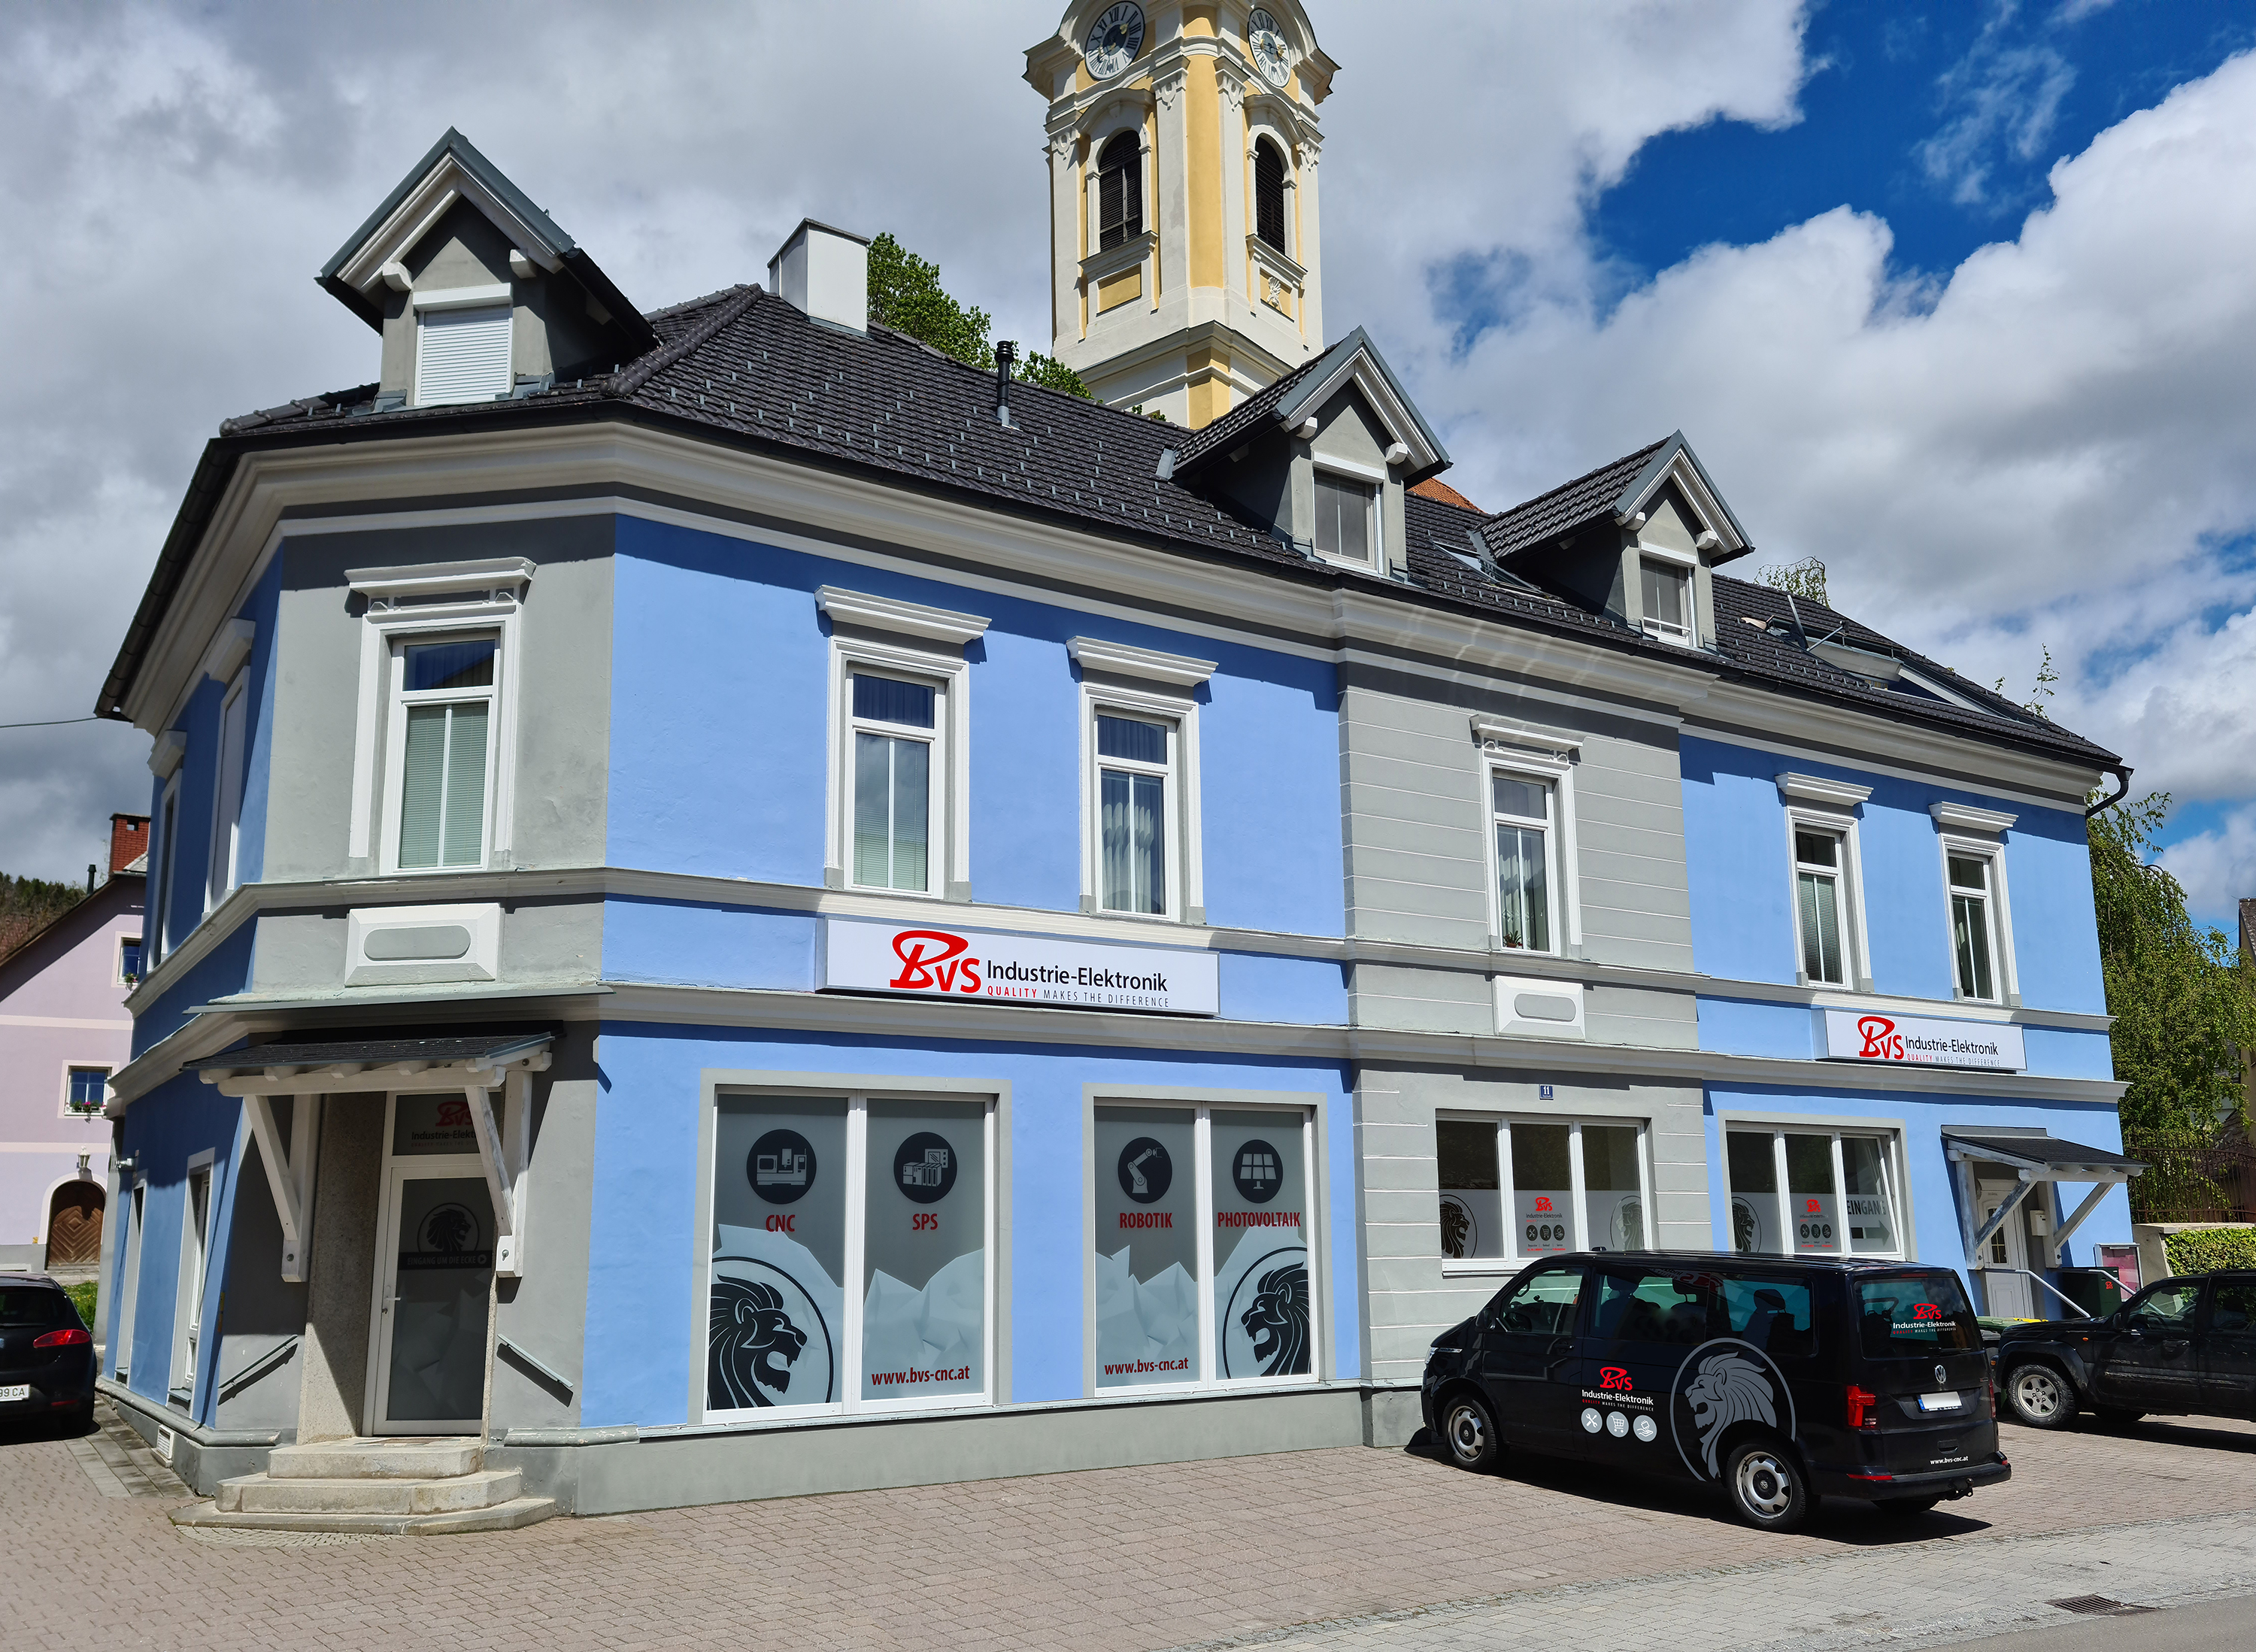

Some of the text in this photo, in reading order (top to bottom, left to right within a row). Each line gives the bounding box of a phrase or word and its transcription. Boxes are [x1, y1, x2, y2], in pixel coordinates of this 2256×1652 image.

[1108, 6, 1120, 23] XII
[1090, 35, 1102, 44] X
[890, 929, 982, 994] BVS
[987, 959, 1169, 993] Industrie-Elektronik
[987, 985, 1170, 1008] QUALITY MAKES THE DIFFERENCE
[1857, 1016, 1905, 1060] BVS
[1905, 1035, 1999, 1056] Industrie-Elektronik
[1907, 1053, 2001, 1067] QUALITY MAKES THE DIFFERENCE
[1543, 1086, 1550, 1094] 11
[1536, 1196, 1553, 1211] BVS
[1846, 1200, 1887, 1215] EINGANG
[766, 1214, 796, 1232] CNC
[912, 1213, 938, 1231] SPS
[1120, 1212, 1173, 1229] ROBOTIK
[1217, 1211, 1301, 1227] PHOTOVOLTAIK
[407, 1256, 435, 1266] EINGANG
[437, 1256, 447, 1265] UM
[449, 1256, 460, 1265] DIE
[1913, 1303, 1942, 1320] BVS
[1893, 1320, 1956, 1329] Industrie-Elektronik
[1104, 1357, 1189, 1375] www.bvs-cnc.at
[871, 1365, 970, 1386] www.bvs-cnc.at
[1600, 1366, 1633, 1390] BVS
[12, 1387, 25, 1396] CA
[1581, 1389, 1654, 1405] Industrie-Elektronik
[1627, 1404, 1654, 1412] DIFFERENCE
[1930, 1455, 1969, 1465] www.bvs-cnc.at
